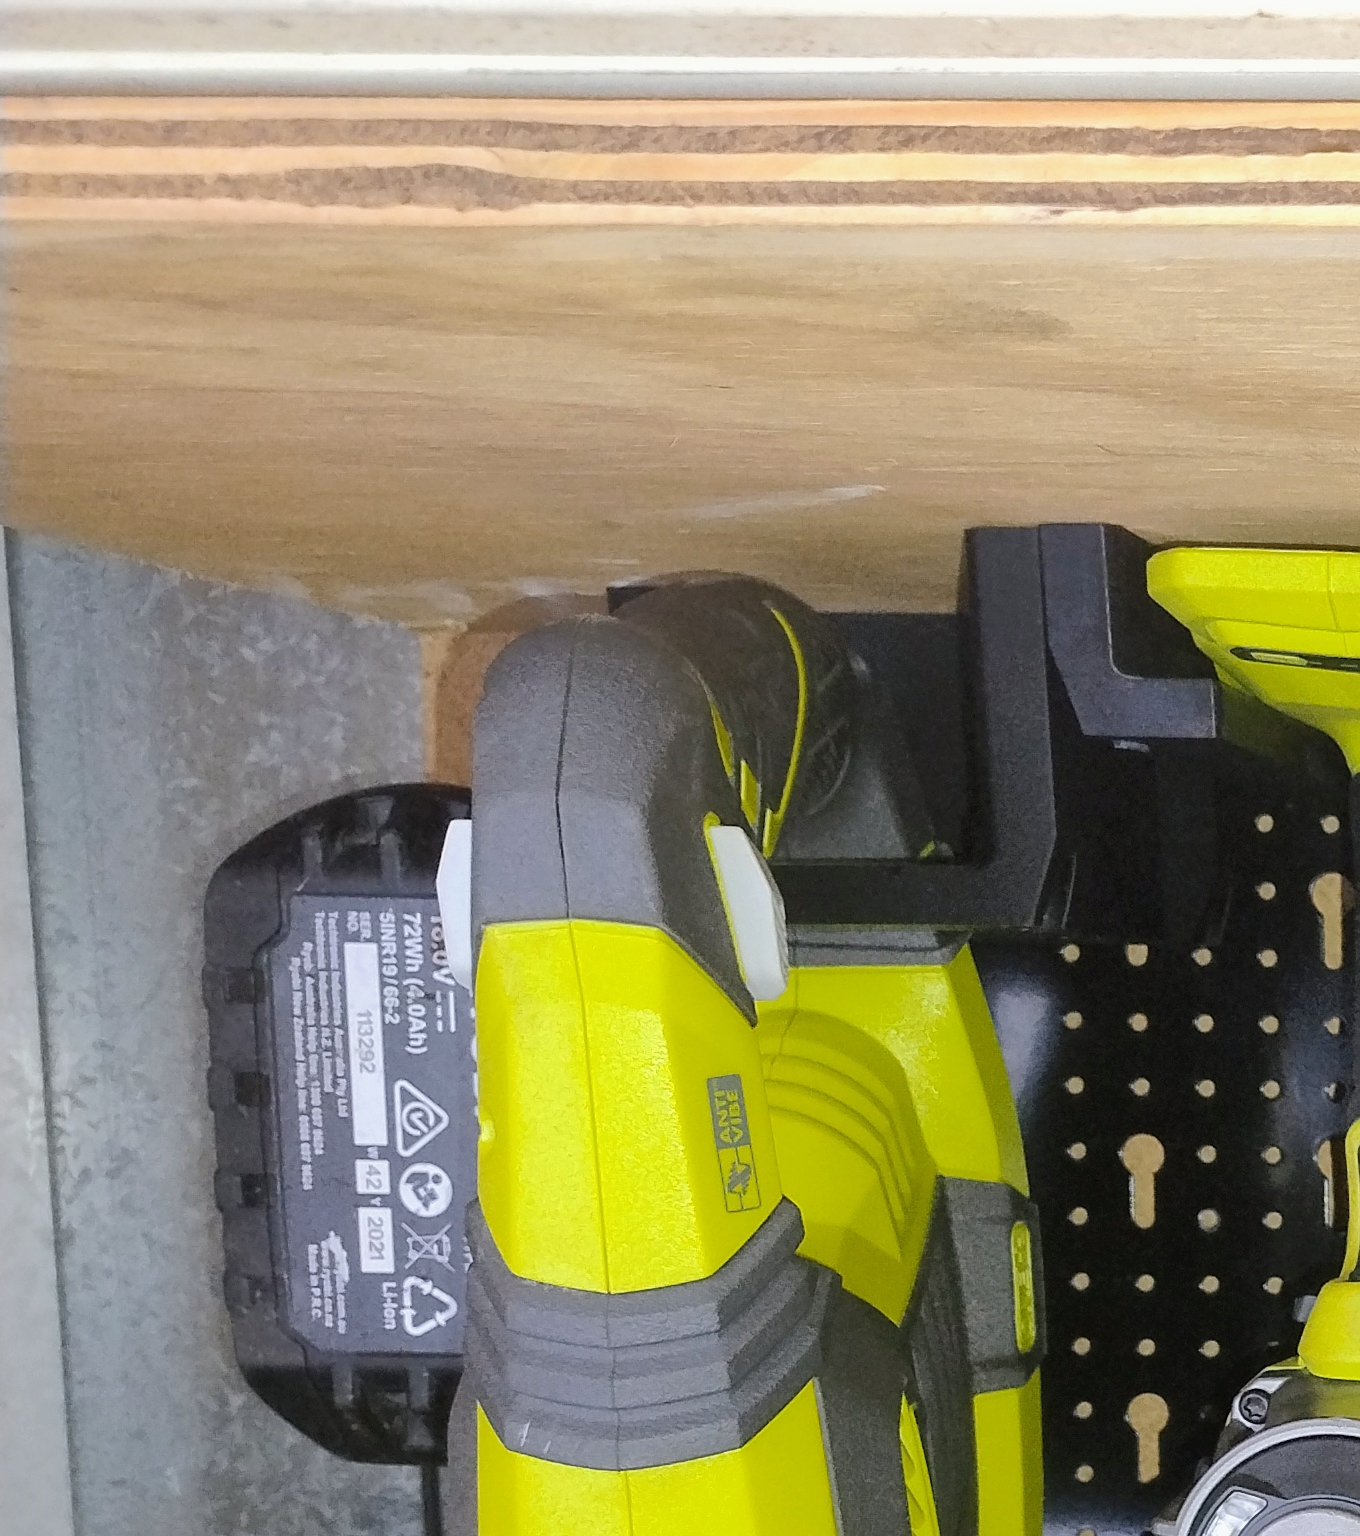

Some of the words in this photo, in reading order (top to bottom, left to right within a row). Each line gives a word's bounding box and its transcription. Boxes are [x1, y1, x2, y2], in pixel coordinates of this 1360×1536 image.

[379, 911, 400, 1025] 5INR19/66-2
[402, 912, 424, 972] 72Wh
[356, 1009, 375, 1075] 113292
[401, 976, 428, 1055] (4.0Ah)
[714, 1090, 732, 1142] ANTI
[727, 1089, 743, 1142] VIBE
[364, 1164, 382, 1190] 42
[367, 1215, 384, 1261] 2021
